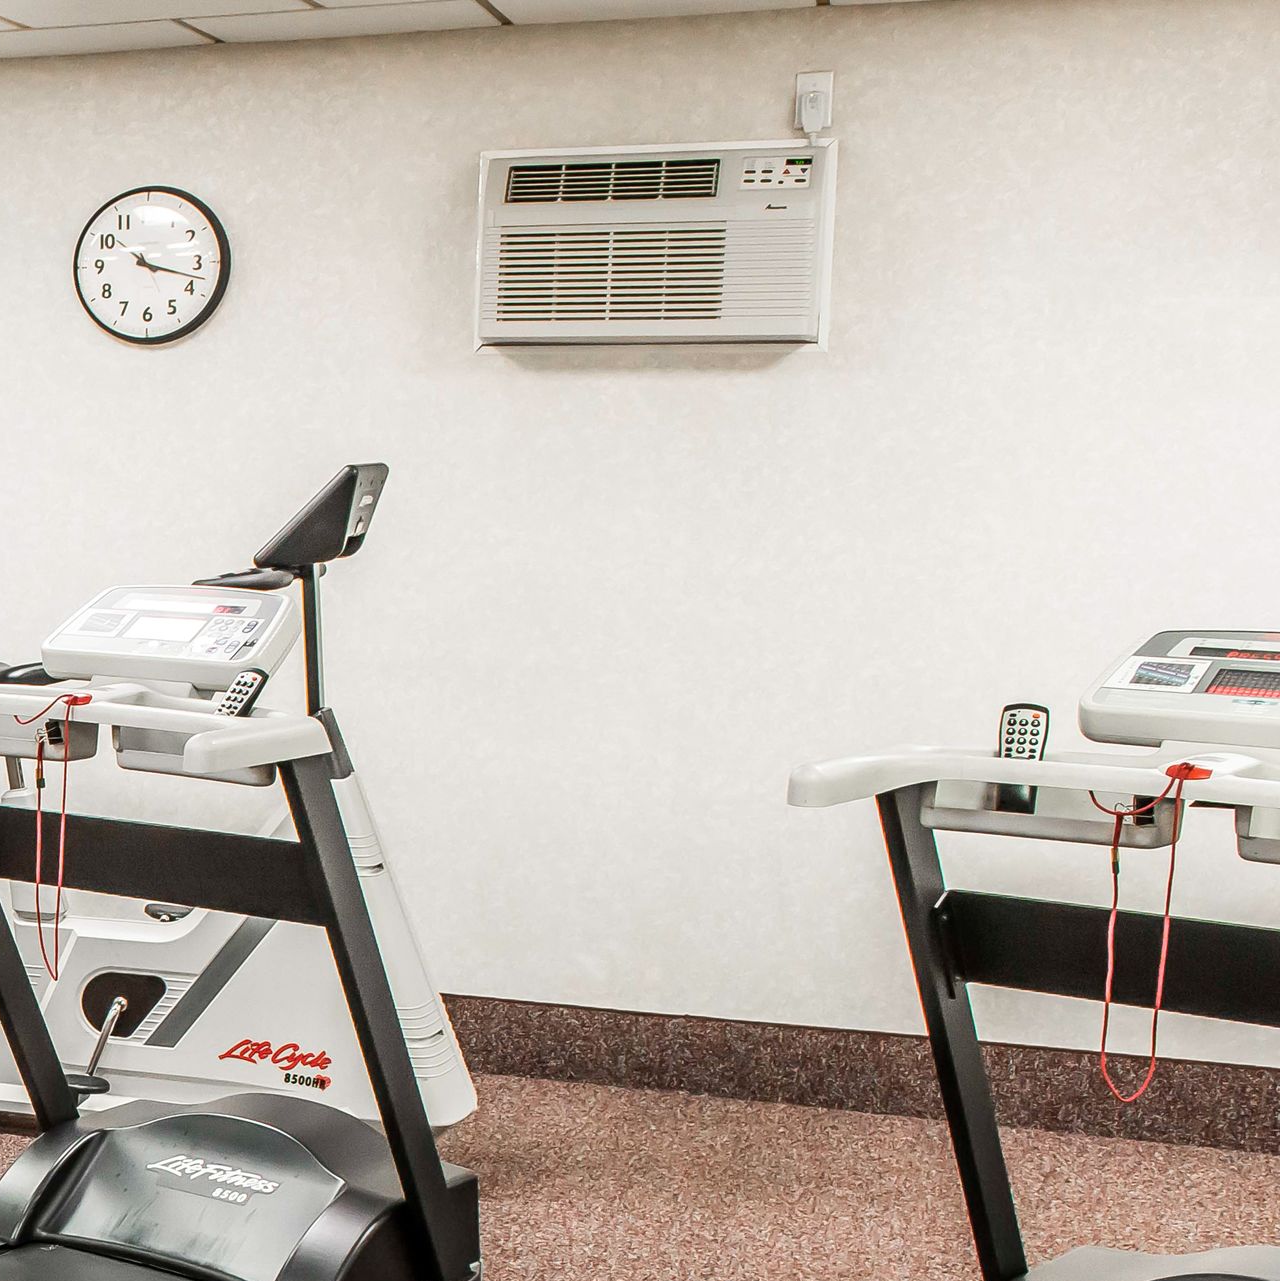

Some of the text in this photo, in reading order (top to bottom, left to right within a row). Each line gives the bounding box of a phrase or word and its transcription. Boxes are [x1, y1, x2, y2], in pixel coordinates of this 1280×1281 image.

[118, 215, 130, 230] 11
[100, 234, 115, 249] 10
[94, 259, 105, 274] 9
[192, 255, 202, 270] 3
[101, 284, 112, 298] 8
[184, 280, 194, 295] 4
[119, 301, 129, 316] 7
[142, 307, 153, 322] 6
[167, 299, 177, 315] 5
[284, 1072, 326, 1090] 8500HR
